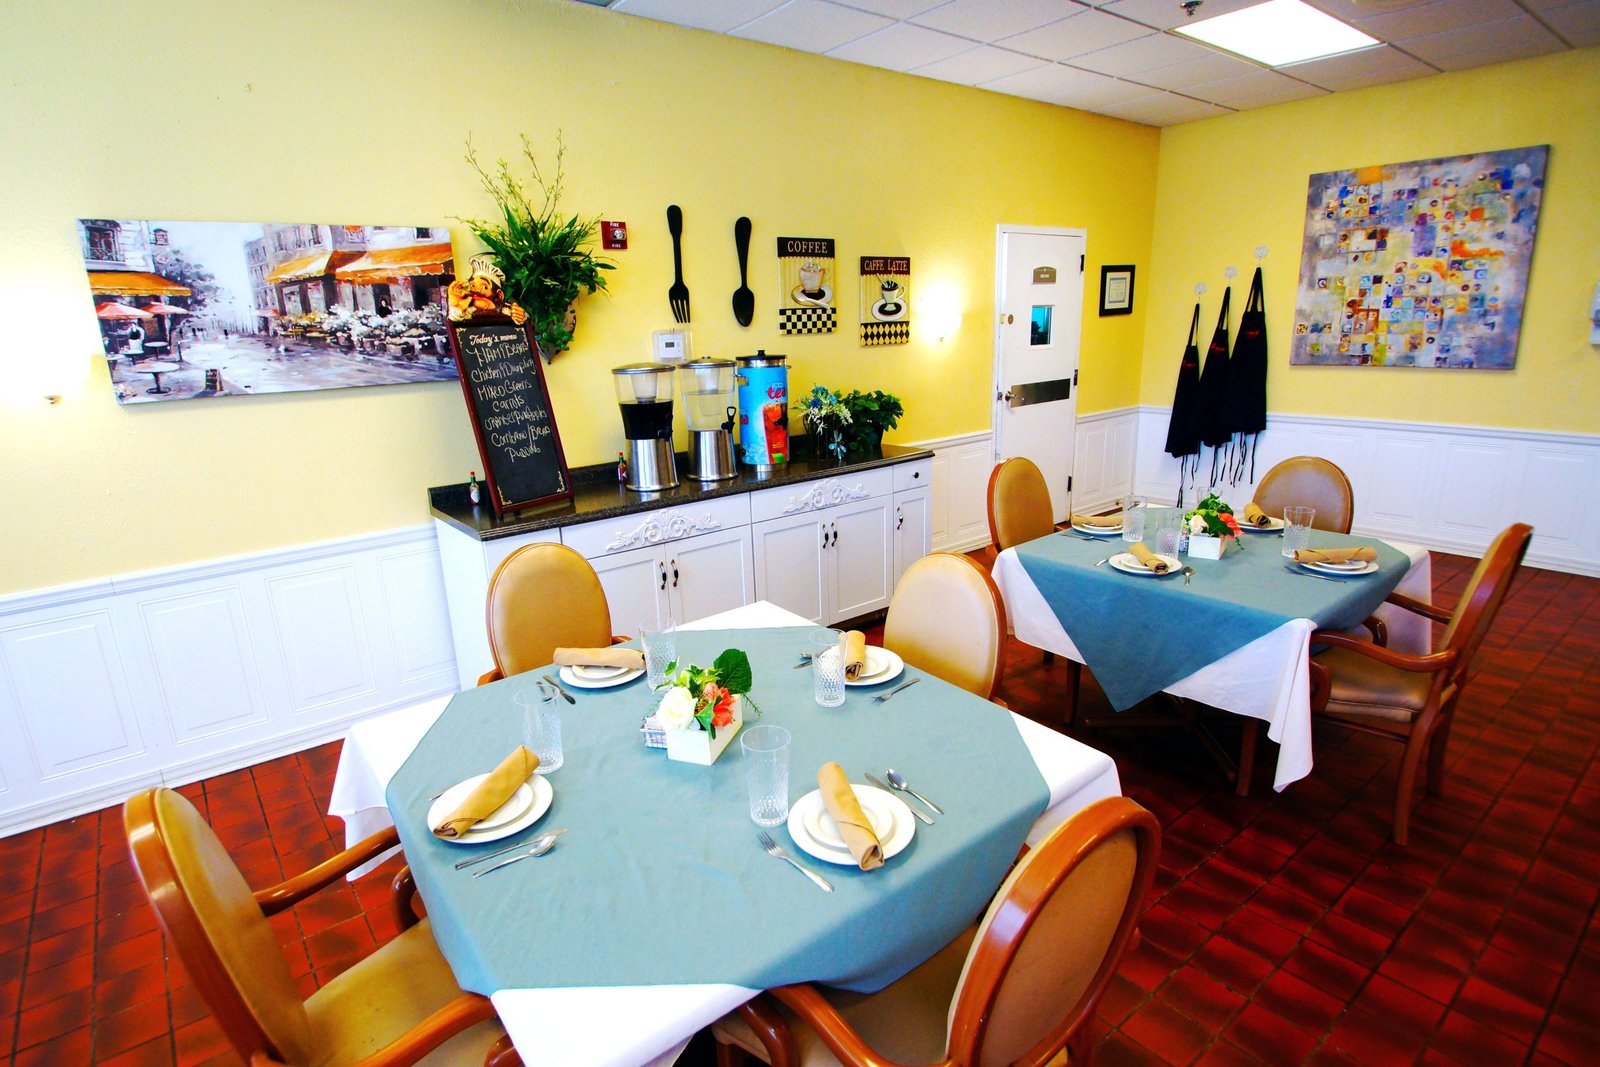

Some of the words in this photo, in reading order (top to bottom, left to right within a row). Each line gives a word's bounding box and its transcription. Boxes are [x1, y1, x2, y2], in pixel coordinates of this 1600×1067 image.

[787, 241, 828, 254] COFFEE
[864, 260, 885, 271] CAFFE
[888, 260, 908, 271] LATTE
[469, 333, 500, 347] Today's
